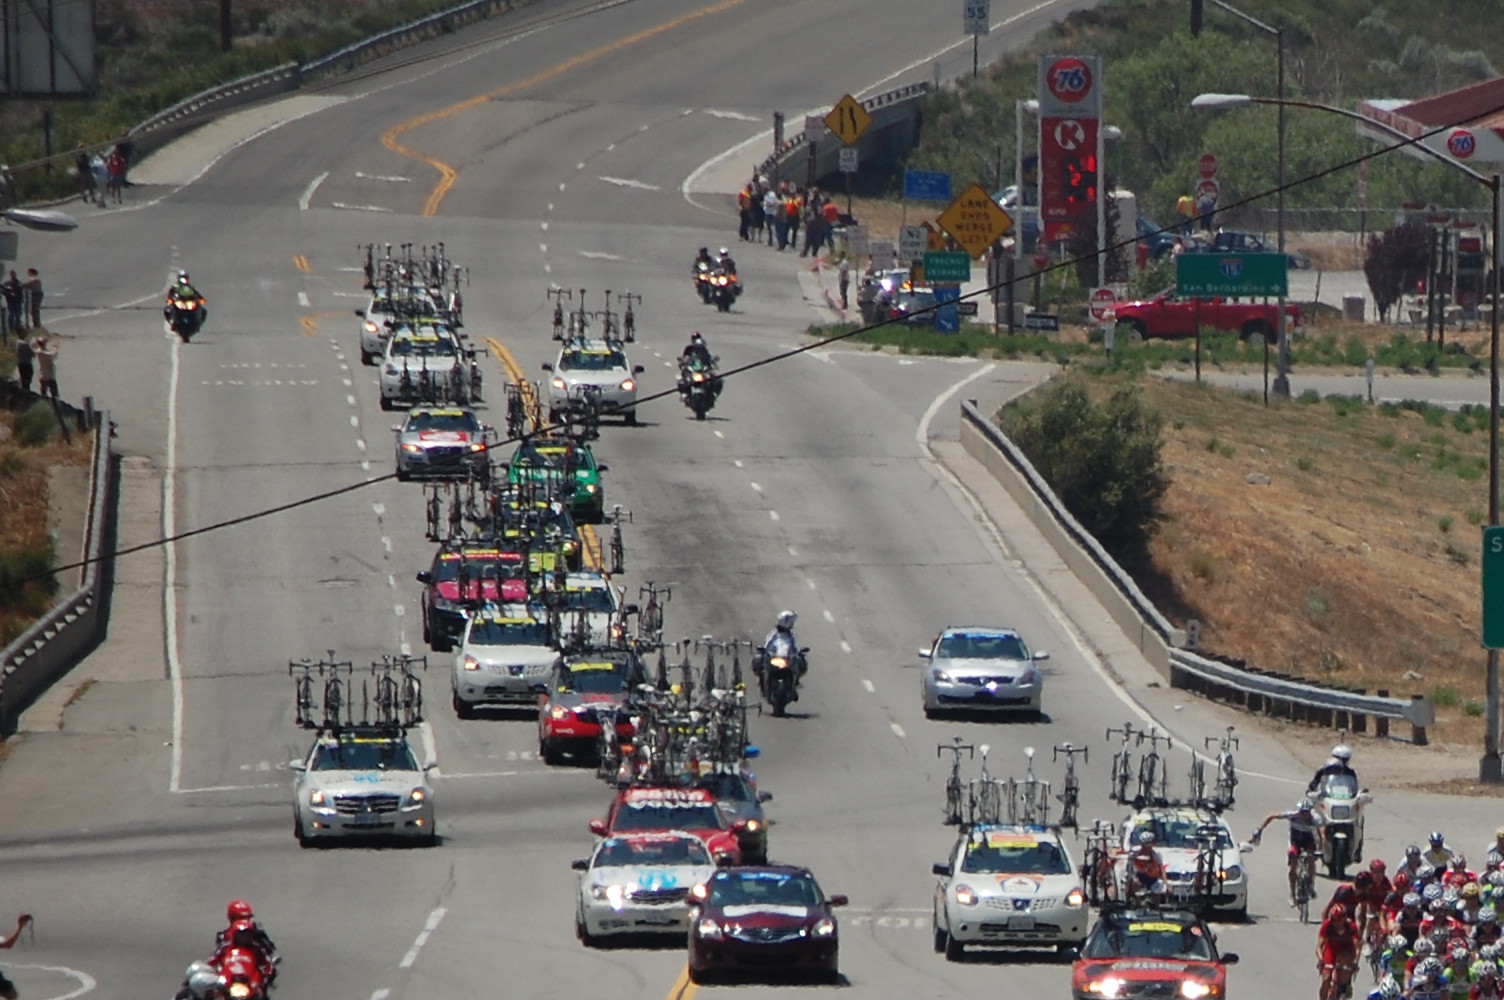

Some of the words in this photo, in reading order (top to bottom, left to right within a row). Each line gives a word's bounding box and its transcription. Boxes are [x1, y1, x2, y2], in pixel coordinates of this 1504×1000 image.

[1054, 66, 1086, 92] 76
[1056, 120, 1085, 150] K
[1452, 135, 1471, 152] 76
[960, 199, 988, 209] LANE
[961, 211, 990, 221] ENDS
[956, 222, 993, 233] MERGE
[907, 230, 921, 239] NO
[962, 234, 988, 244] LEFT
